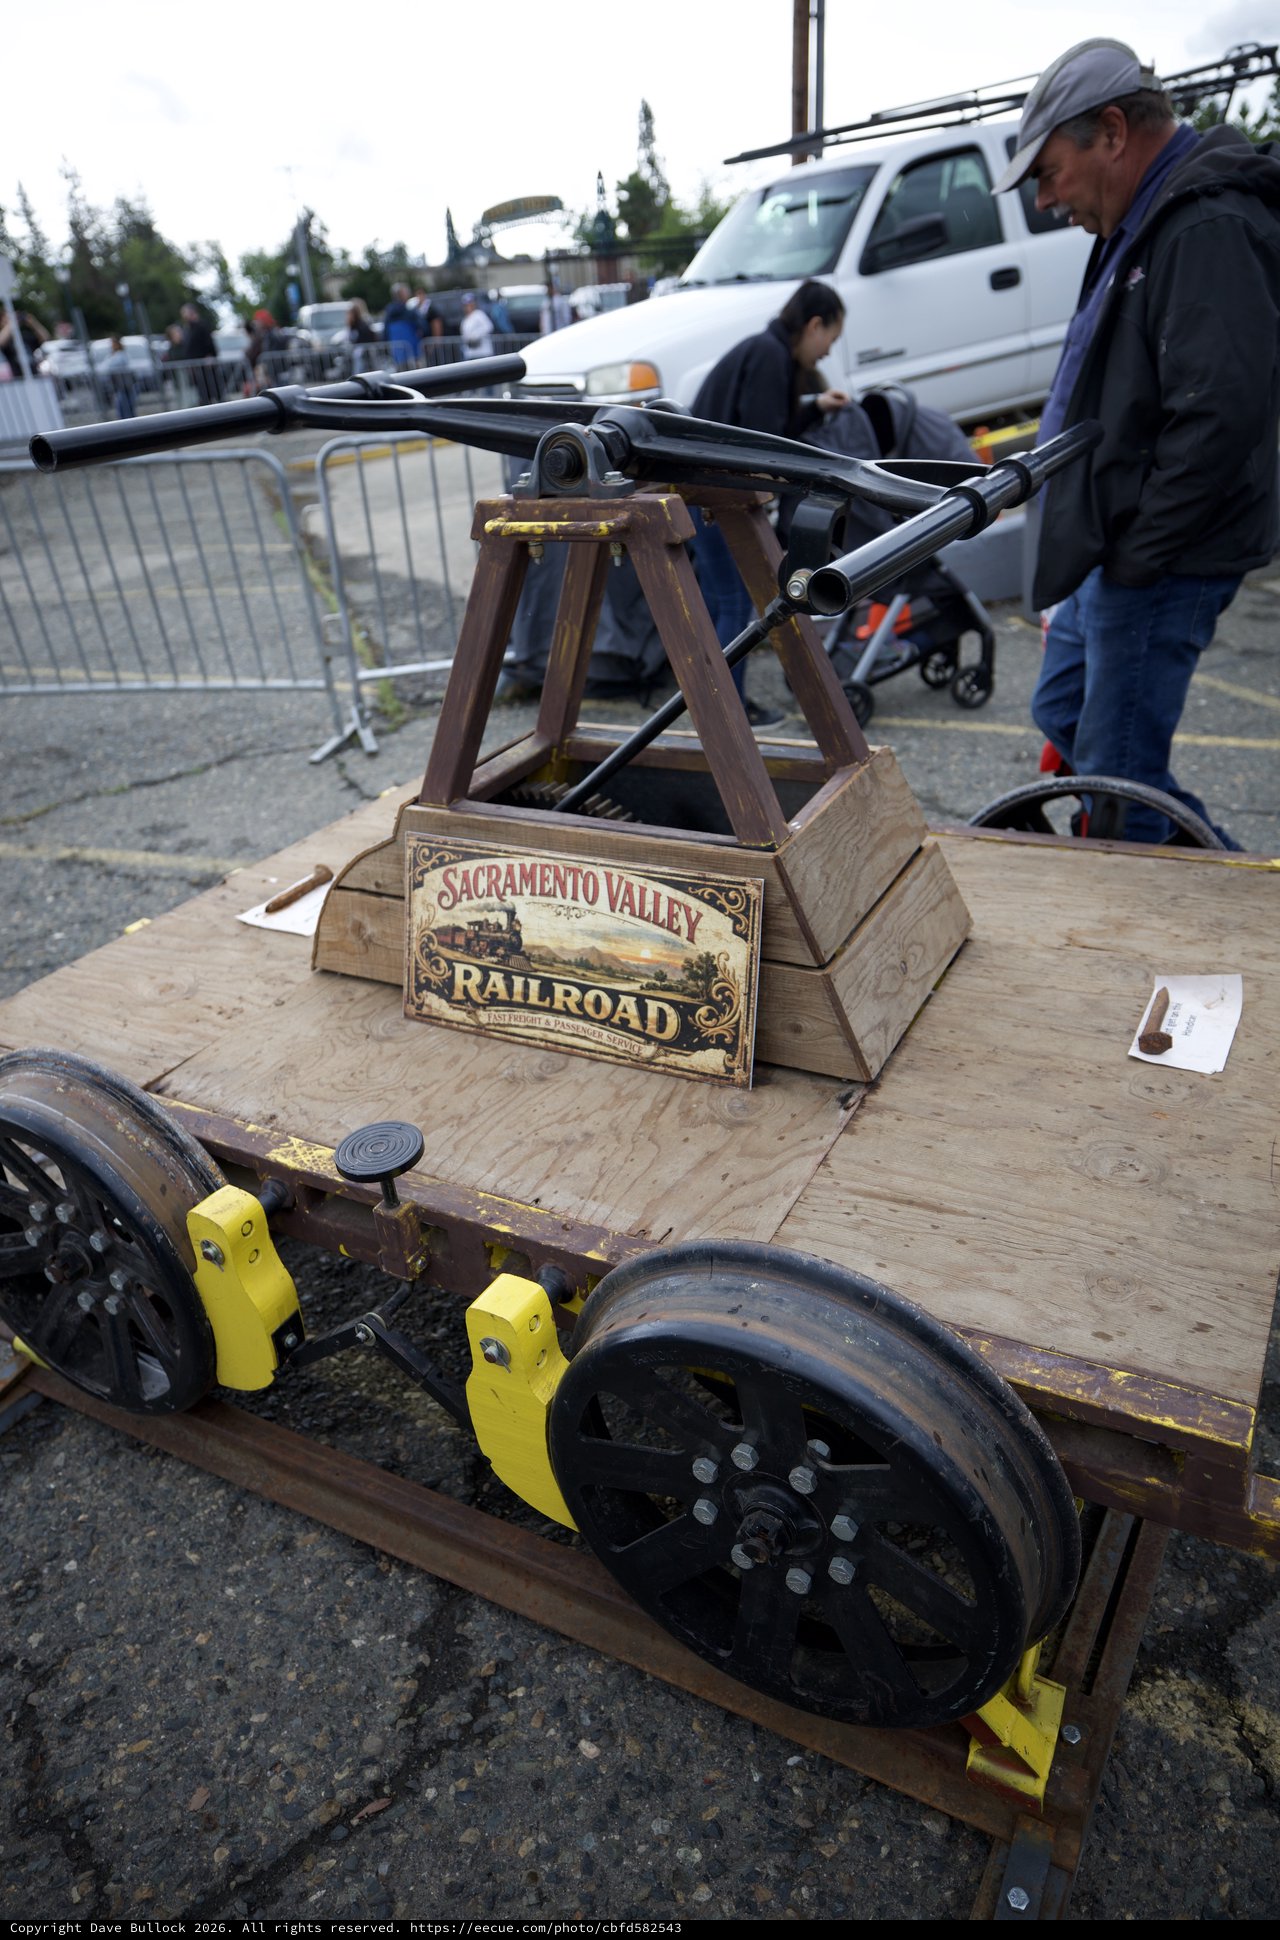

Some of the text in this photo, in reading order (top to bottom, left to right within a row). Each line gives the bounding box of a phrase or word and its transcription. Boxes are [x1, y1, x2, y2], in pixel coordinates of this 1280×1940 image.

[437, 863, 704, 945] SACRAMENTO VALLEY
[451, 962, 681, 1041] RAILROAD
[487, 1013, 643, 1055] FAST FREIGHT & PASSENGER SERVICE
